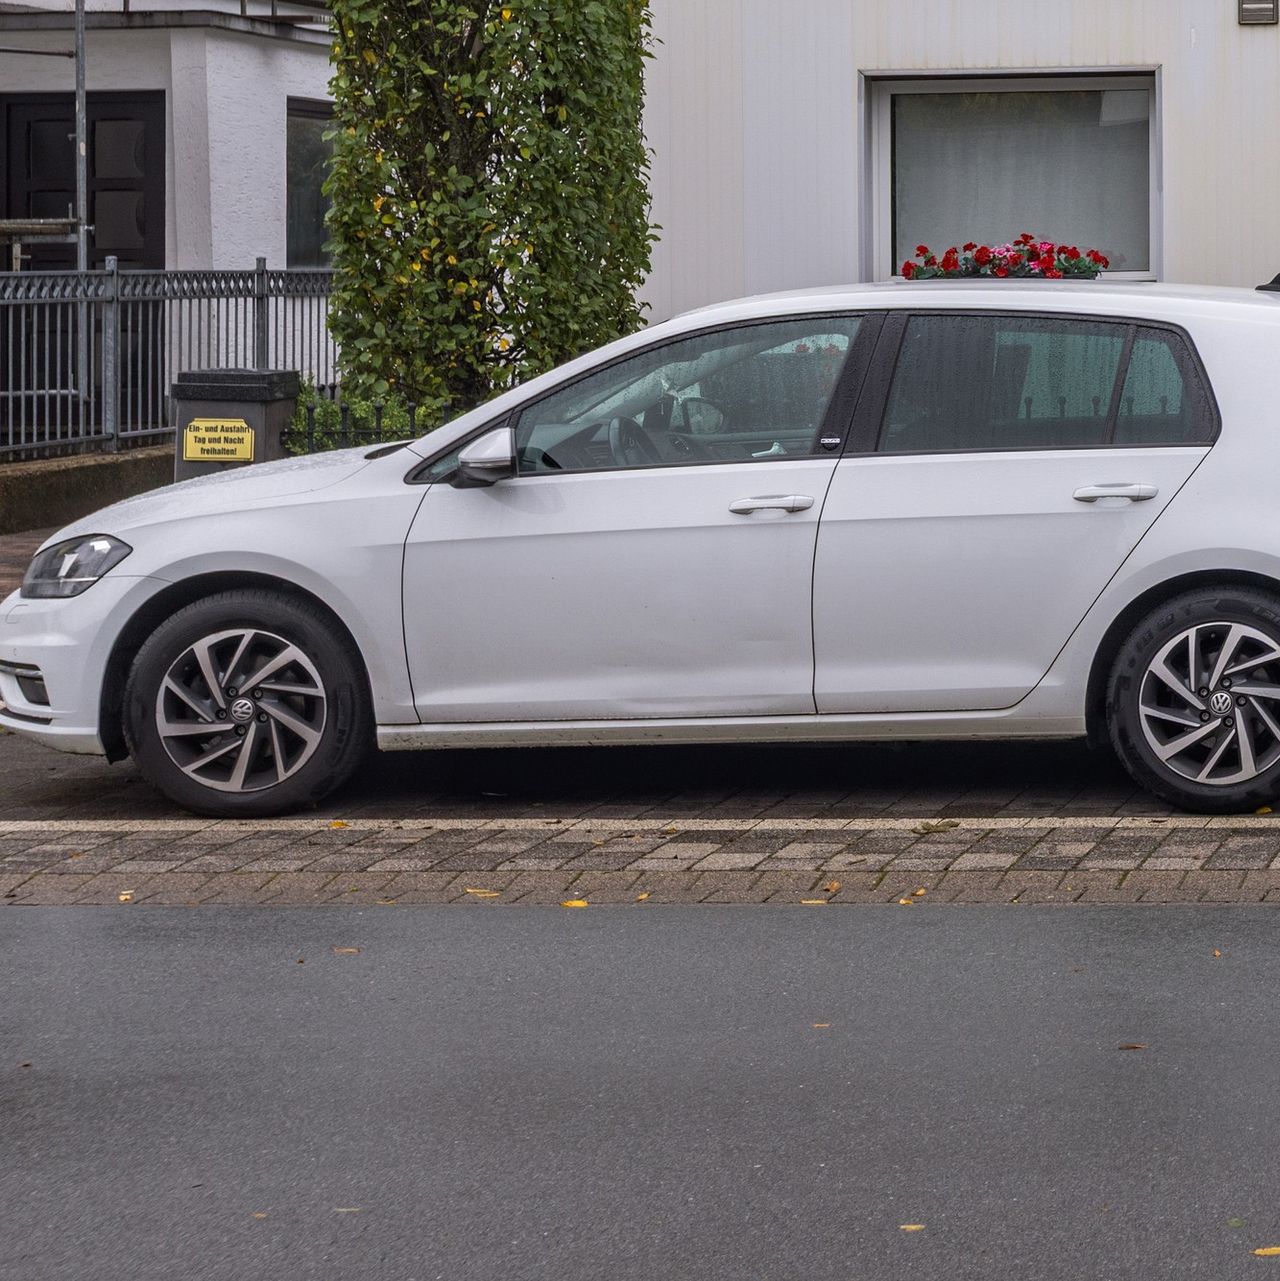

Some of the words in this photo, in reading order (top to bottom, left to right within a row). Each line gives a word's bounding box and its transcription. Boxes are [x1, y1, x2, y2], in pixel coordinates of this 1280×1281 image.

[188, 424, 203, 433] Ein-
[204, 424, 219, 433] und
[194, 436, 207, 444] Tag
[208, 436, 222, 444] und
[224, 436, 245, 444] Nacht
[200, 447, 237, 456] freihalten!
